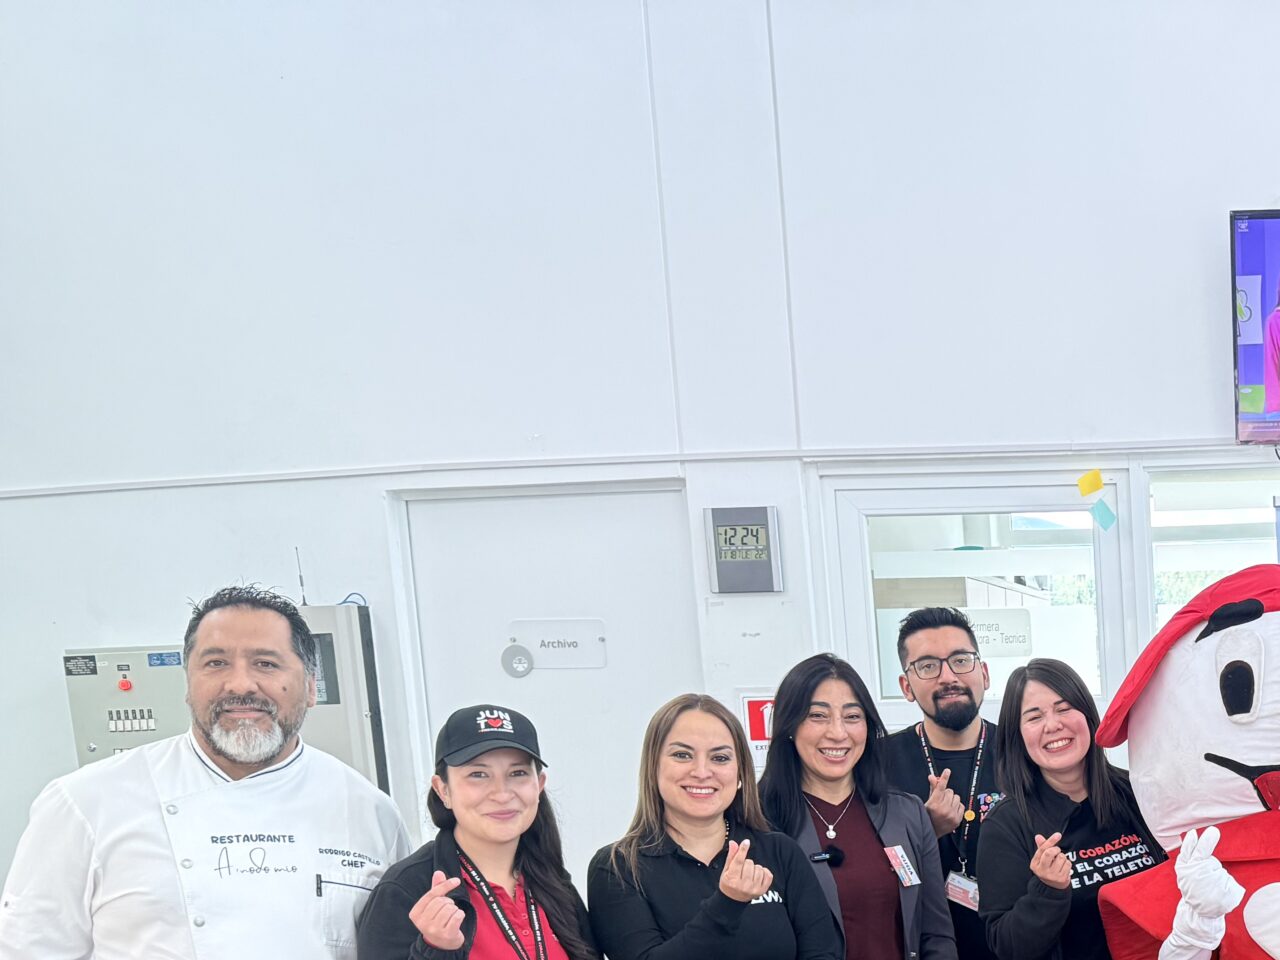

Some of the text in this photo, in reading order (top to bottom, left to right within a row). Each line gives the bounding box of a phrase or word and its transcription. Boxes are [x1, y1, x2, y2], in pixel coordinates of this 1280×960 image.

[539, 640, 578, 649] Archivo
[211, 833, 295, 845] RESTAURANTE
[341, 859, 366, 869] CHEF
[1083, 873, 1104, 886] LA
